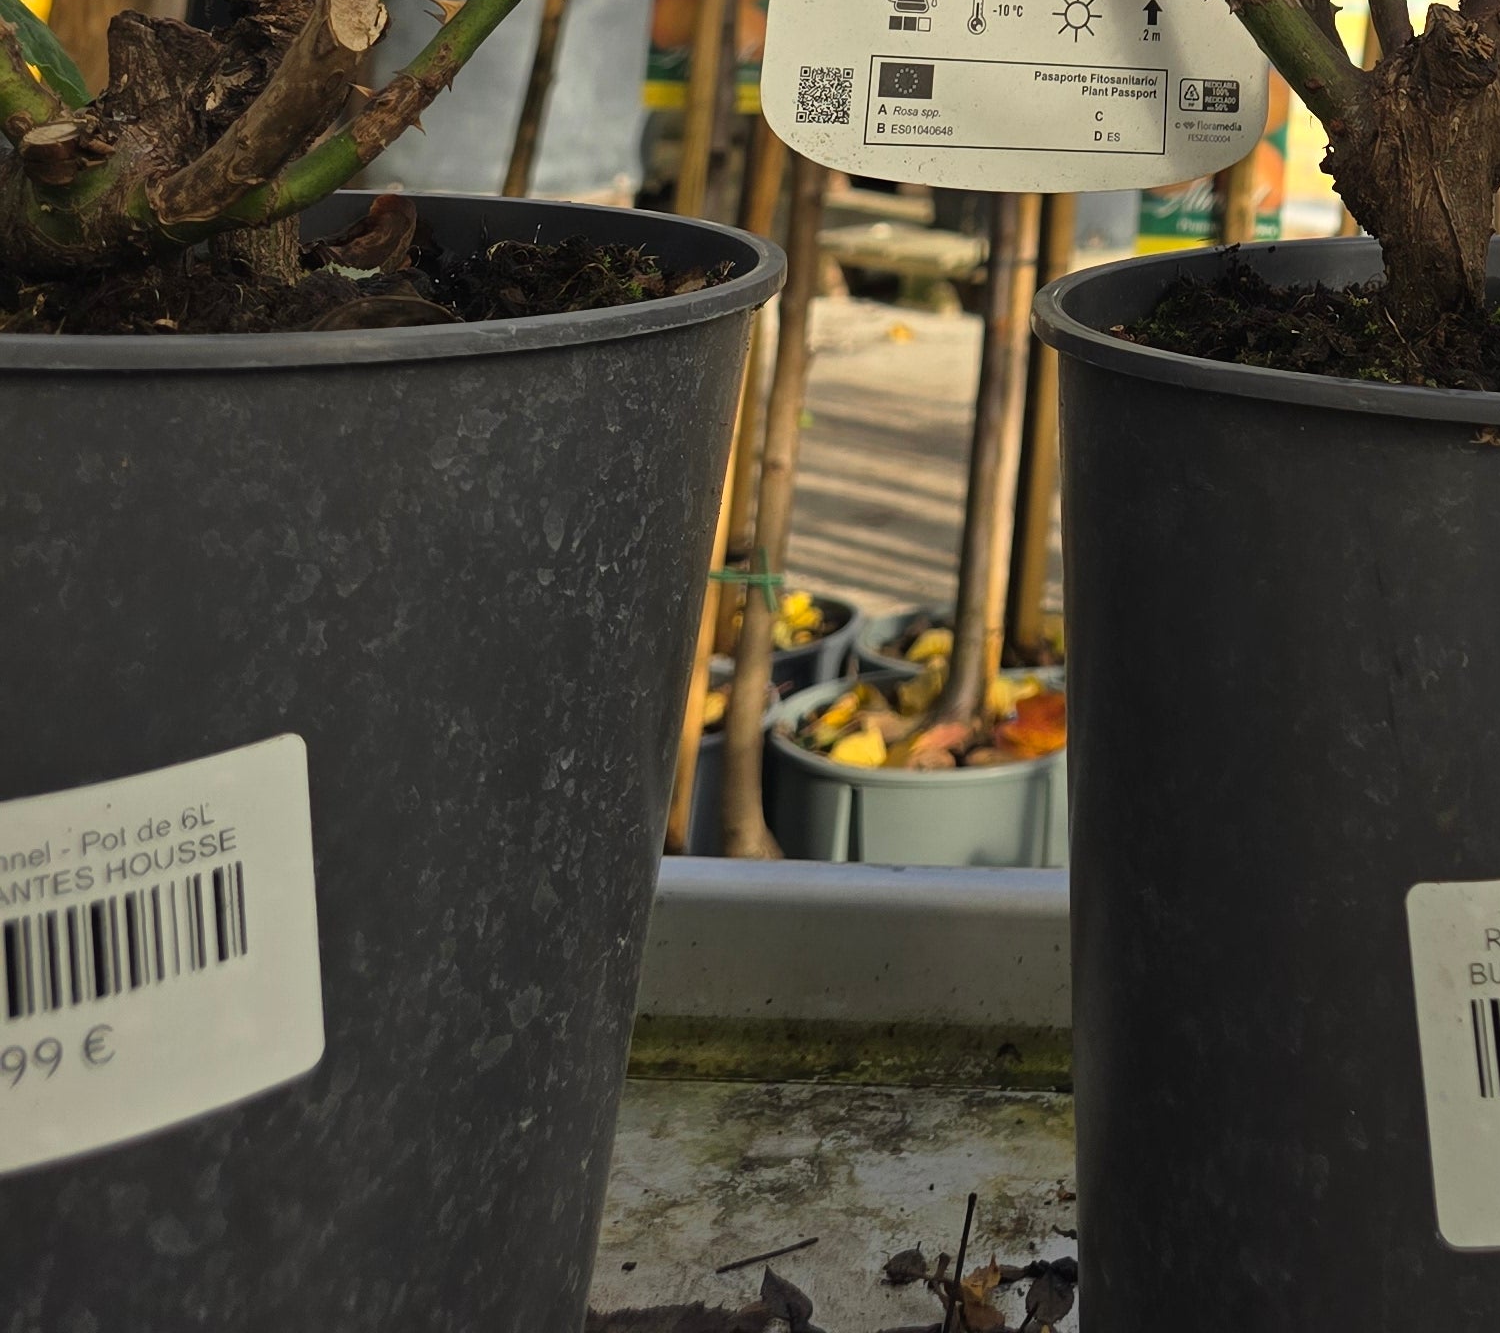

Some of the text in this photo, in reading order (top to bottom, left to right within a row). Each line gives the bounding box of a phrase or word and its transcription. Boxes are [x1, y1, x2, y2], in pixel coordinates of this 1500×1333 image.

[1142, 28, 1160, 41] 2 m
[1033, 70, 1158, 86] Pasaporte Fitosanitario/
[1081, 85, 1157, 100] Plant Passport
[877, 103, 941, 119] A Rosa spp.
[1094, 110, 1103, 122] C
[876, 122, 953, 136] B ES01040648
[1197, 121, 1242, 131] floramedia
[1093, 130, 1120, 142] D ES
[138, 818, 172, 842] de
[181, 803, 216, 831] 6L
[106, 827, 237, 883] HOUSSE
[84, 1024, 116, 1065] €
